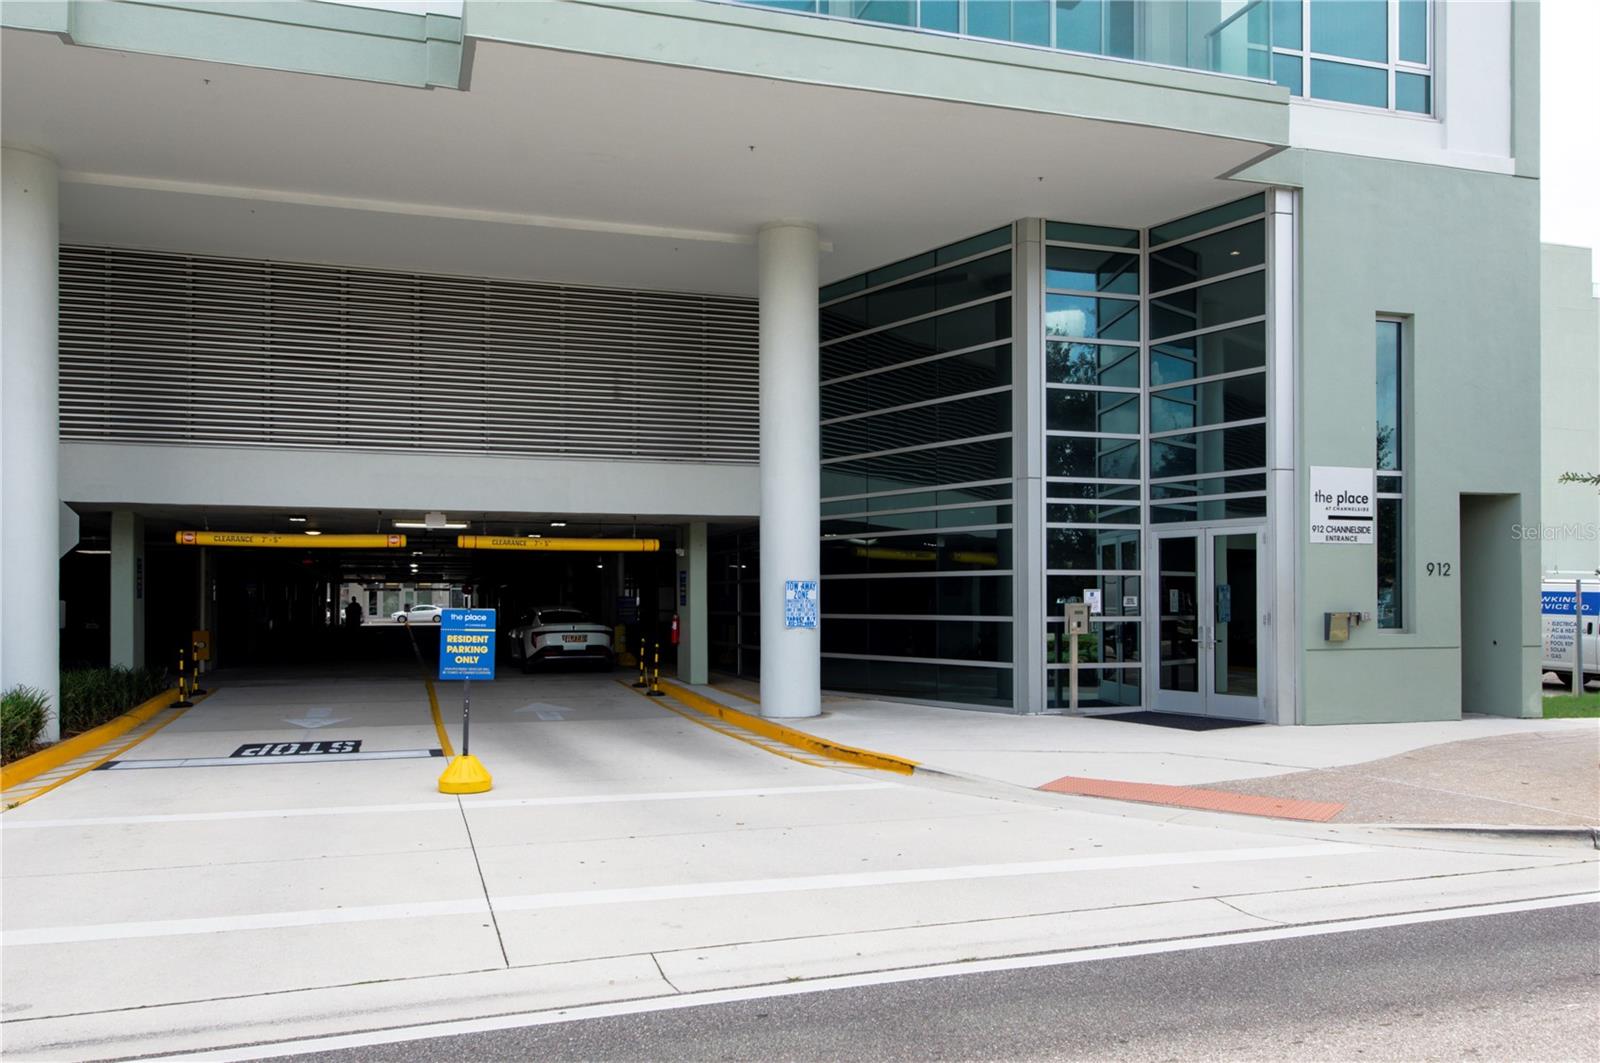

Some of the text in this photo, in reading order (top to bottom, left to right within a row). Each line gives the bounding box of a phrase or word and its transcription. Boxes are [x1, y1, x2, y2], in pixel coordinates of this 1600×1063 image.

[1314, 489, 1369, 506] the place
[1311, 525, 1371, 534] 912 CHANNELSIDE
[213, 535, 254, 543] CLEARANCE
[491, 538, 527, 546] CLEARANCE
[1426, 562, 1451, 577] 912
[786, 581, 816, 590] TOW AWAY
[794, 590, 809, 599] ZONE
[450, 613, 487, 622] the place
[446, 634, 489, 643] RESIDENT
[446, 645, 488, 654] PARKING
[455, 655, 479, 664] ONLY
[241, 742, 355, 756] STOP
